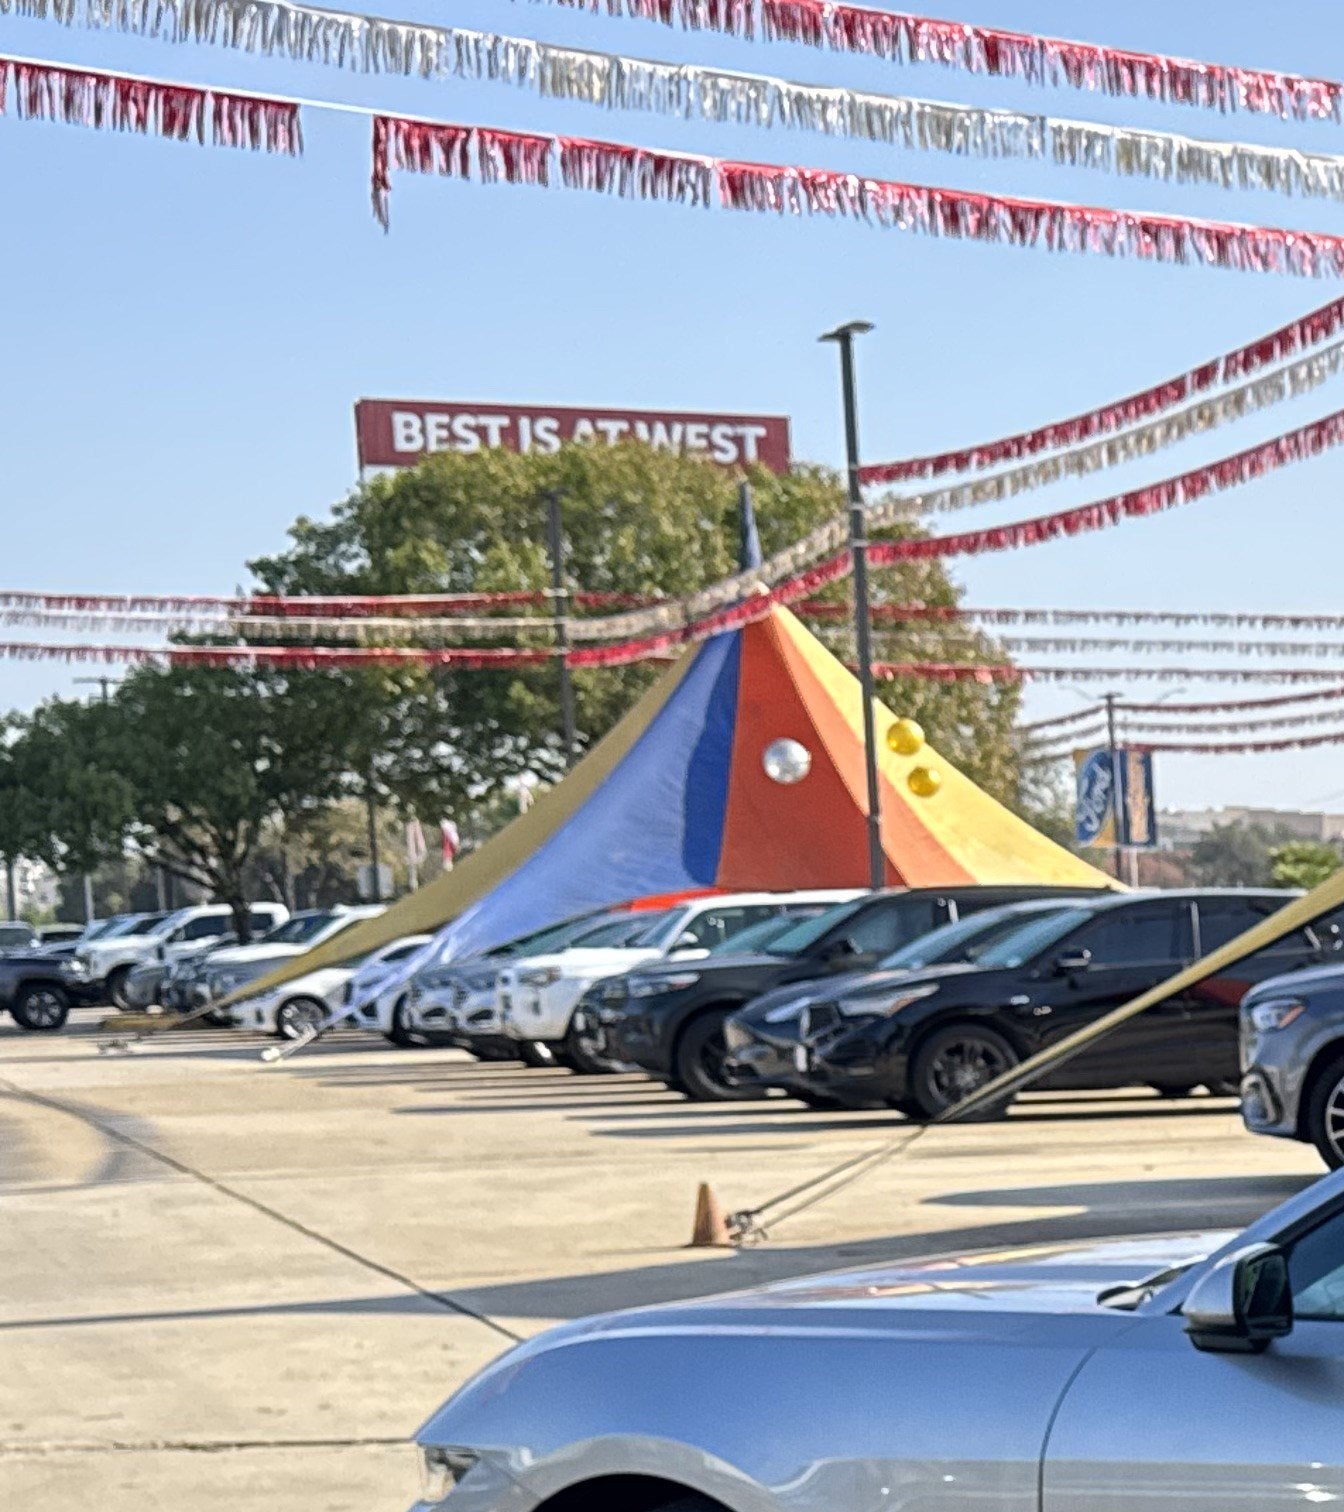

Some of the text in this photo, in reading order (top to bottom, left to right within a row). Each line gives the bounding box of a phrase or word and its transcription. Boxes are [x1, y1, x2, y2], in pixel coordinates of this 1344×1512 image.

[392, 411, 510, 453] BEST
[518, 416, 563, 456] IS
[633, 420, 768, 465] WEST
